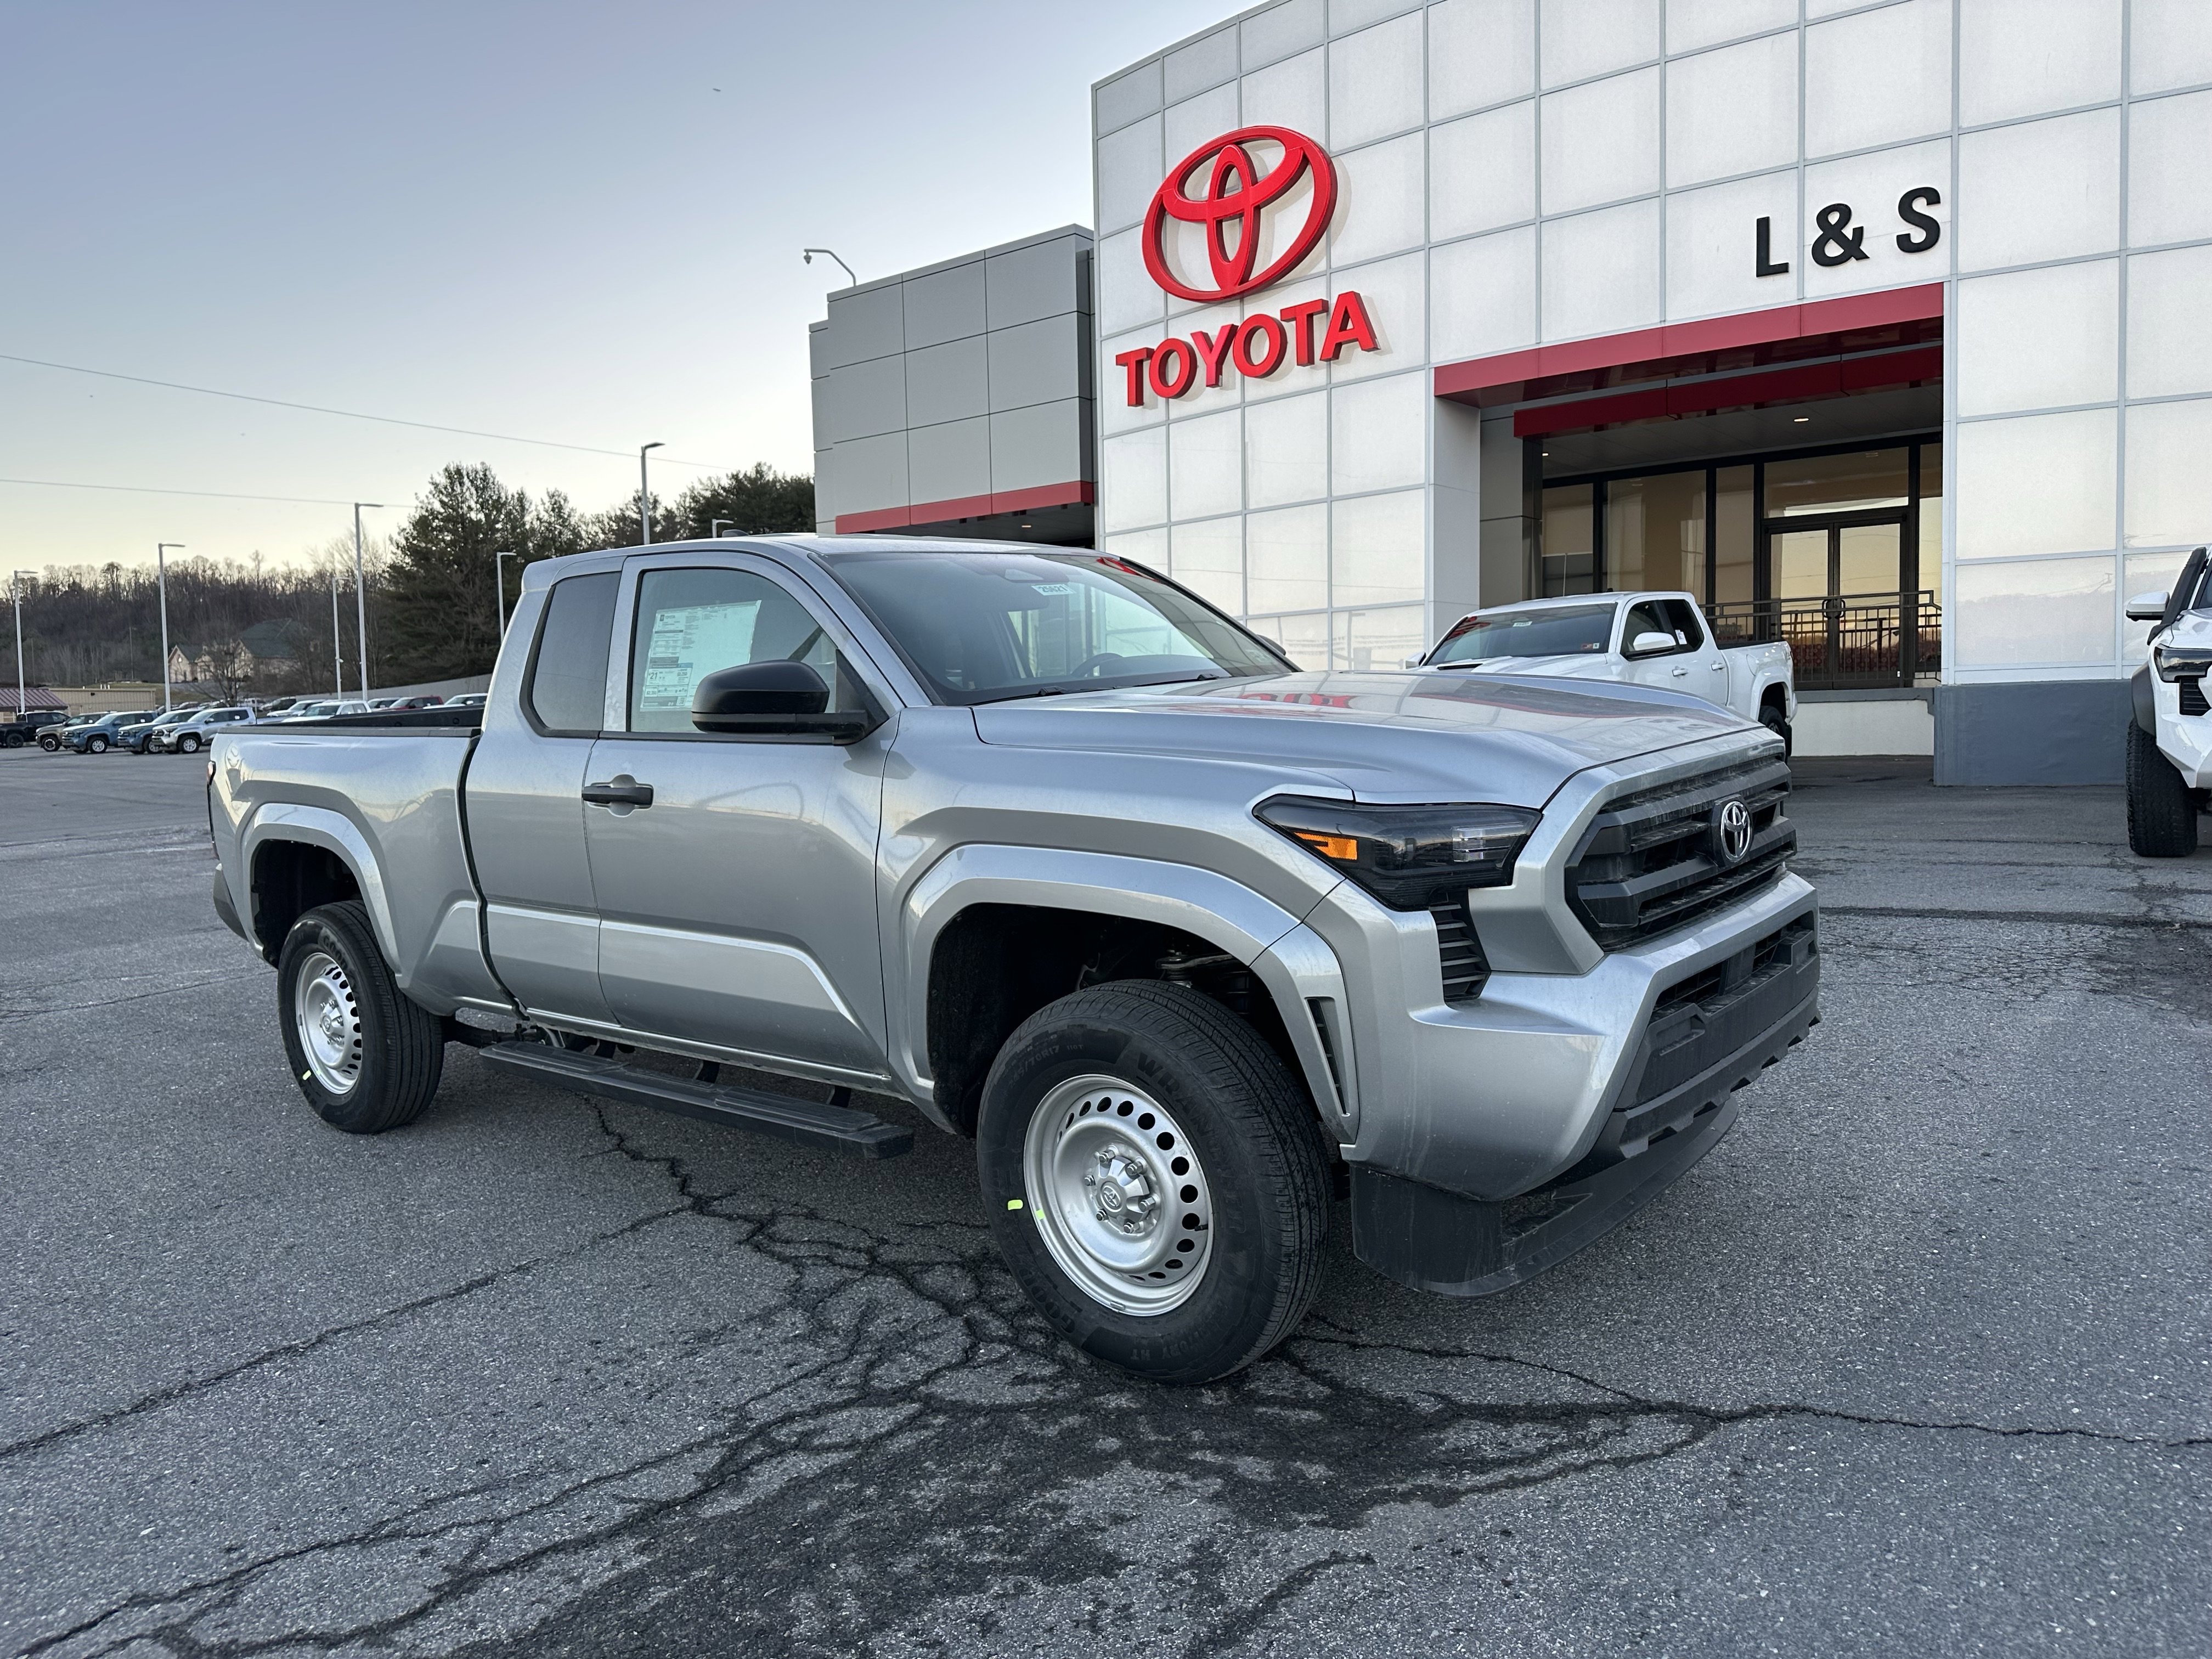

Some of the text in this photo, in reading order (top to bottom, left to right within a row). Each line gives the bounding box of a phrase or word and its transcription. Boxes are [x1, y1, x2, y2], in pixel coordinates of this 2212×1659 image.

[1756, 187, 1941, 278] L & S
[1116, 291, 1381, 407] TOYOTA
